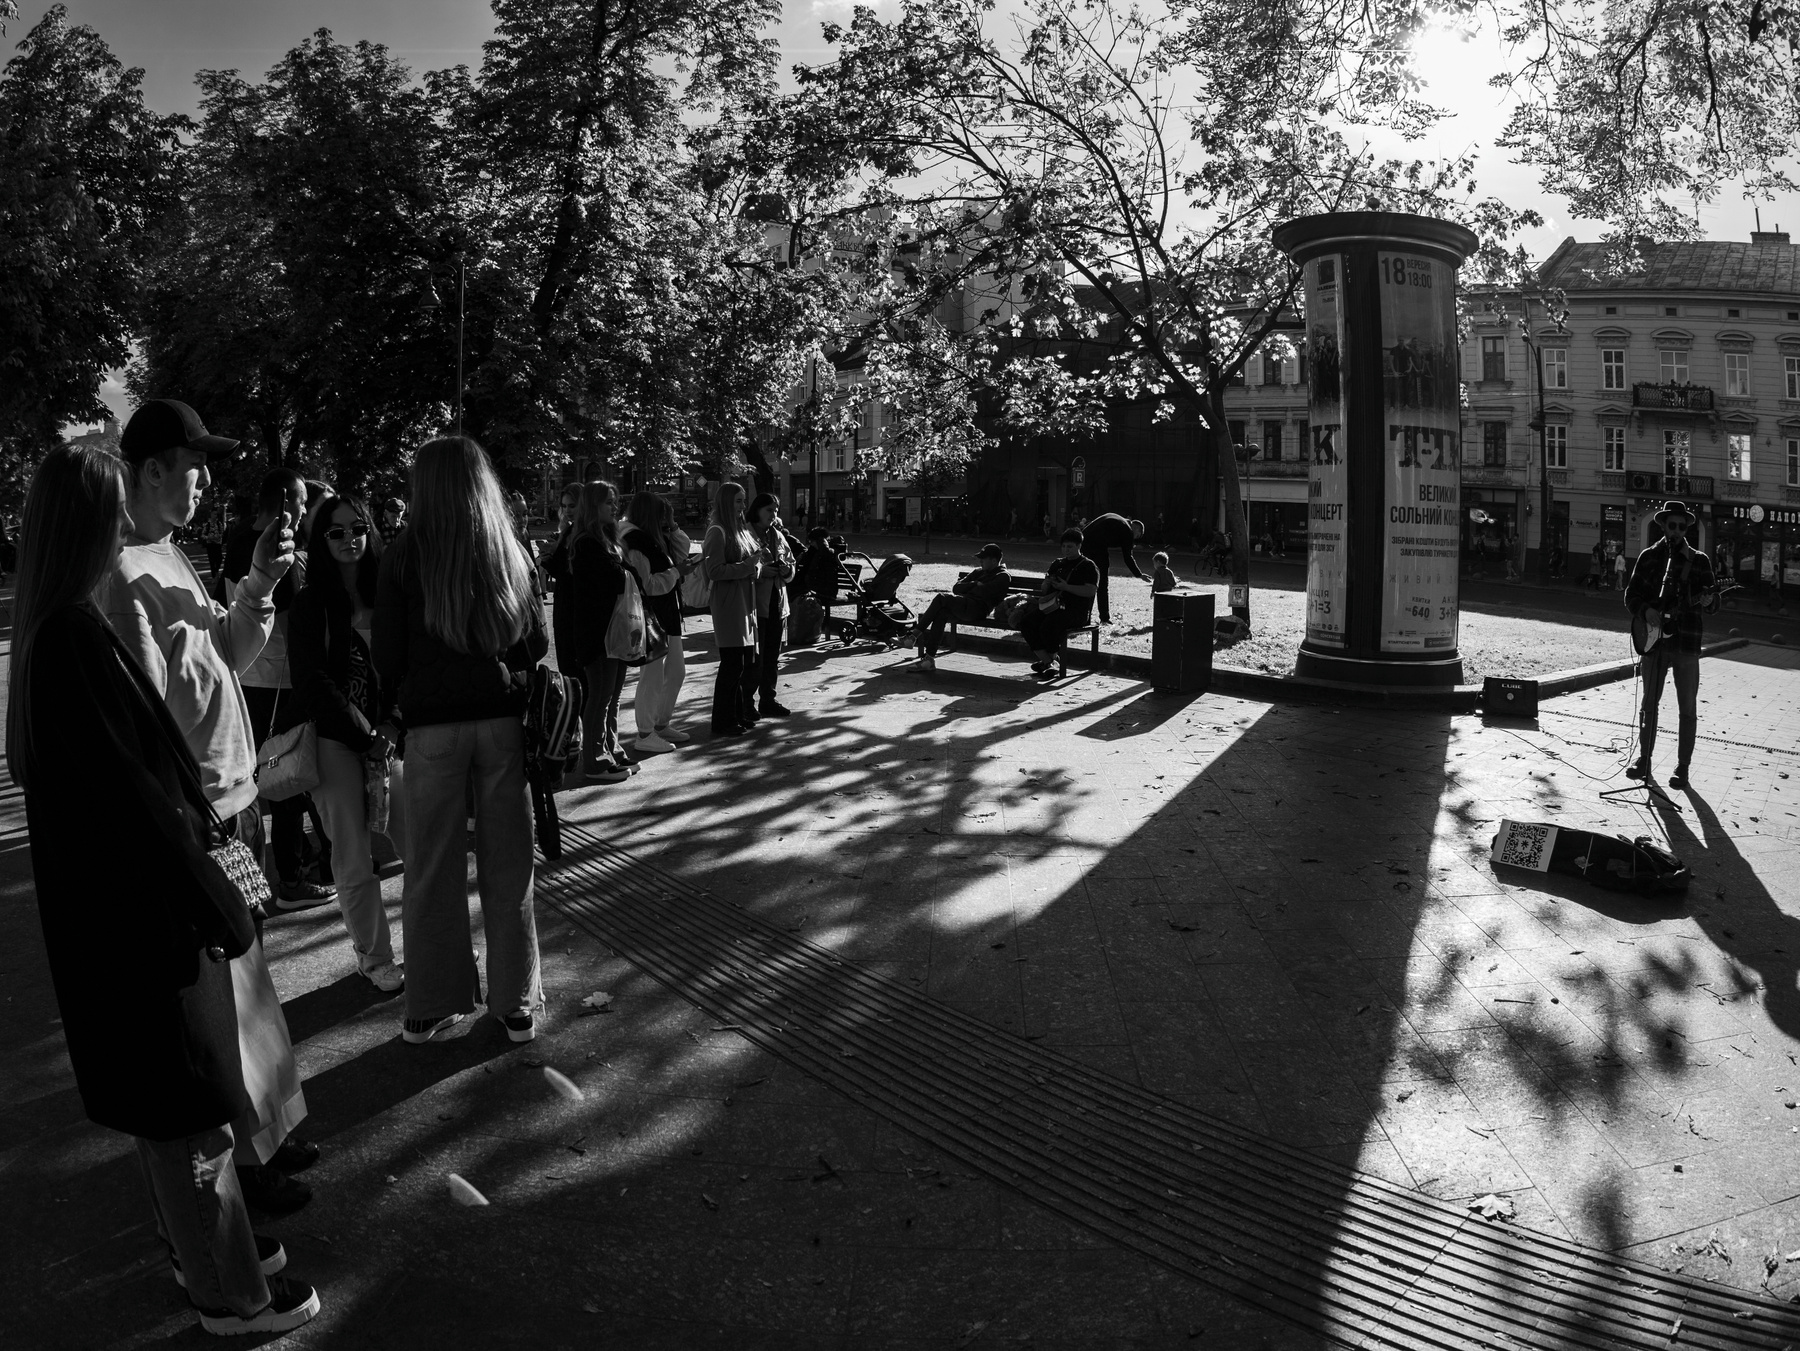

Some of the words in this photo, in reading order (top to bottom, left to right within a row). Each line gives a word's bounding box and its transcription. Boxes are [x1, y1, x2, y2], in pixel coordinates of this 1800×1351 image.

[1381, 257, 1406, 285] 18
[1408, 272, 1432, 289] 18:00
[1419, 484, 1457, 504] ВЕЛИКИЙ
[1309, 503, 1343, 522] ОНЦЕРТ
[1390, 504, 1442, 526] СОЛЬНИЙ
[1391, 536, 1415, 545] ЗІБРАНІ
[1412, 605, 1430, 619] 640
